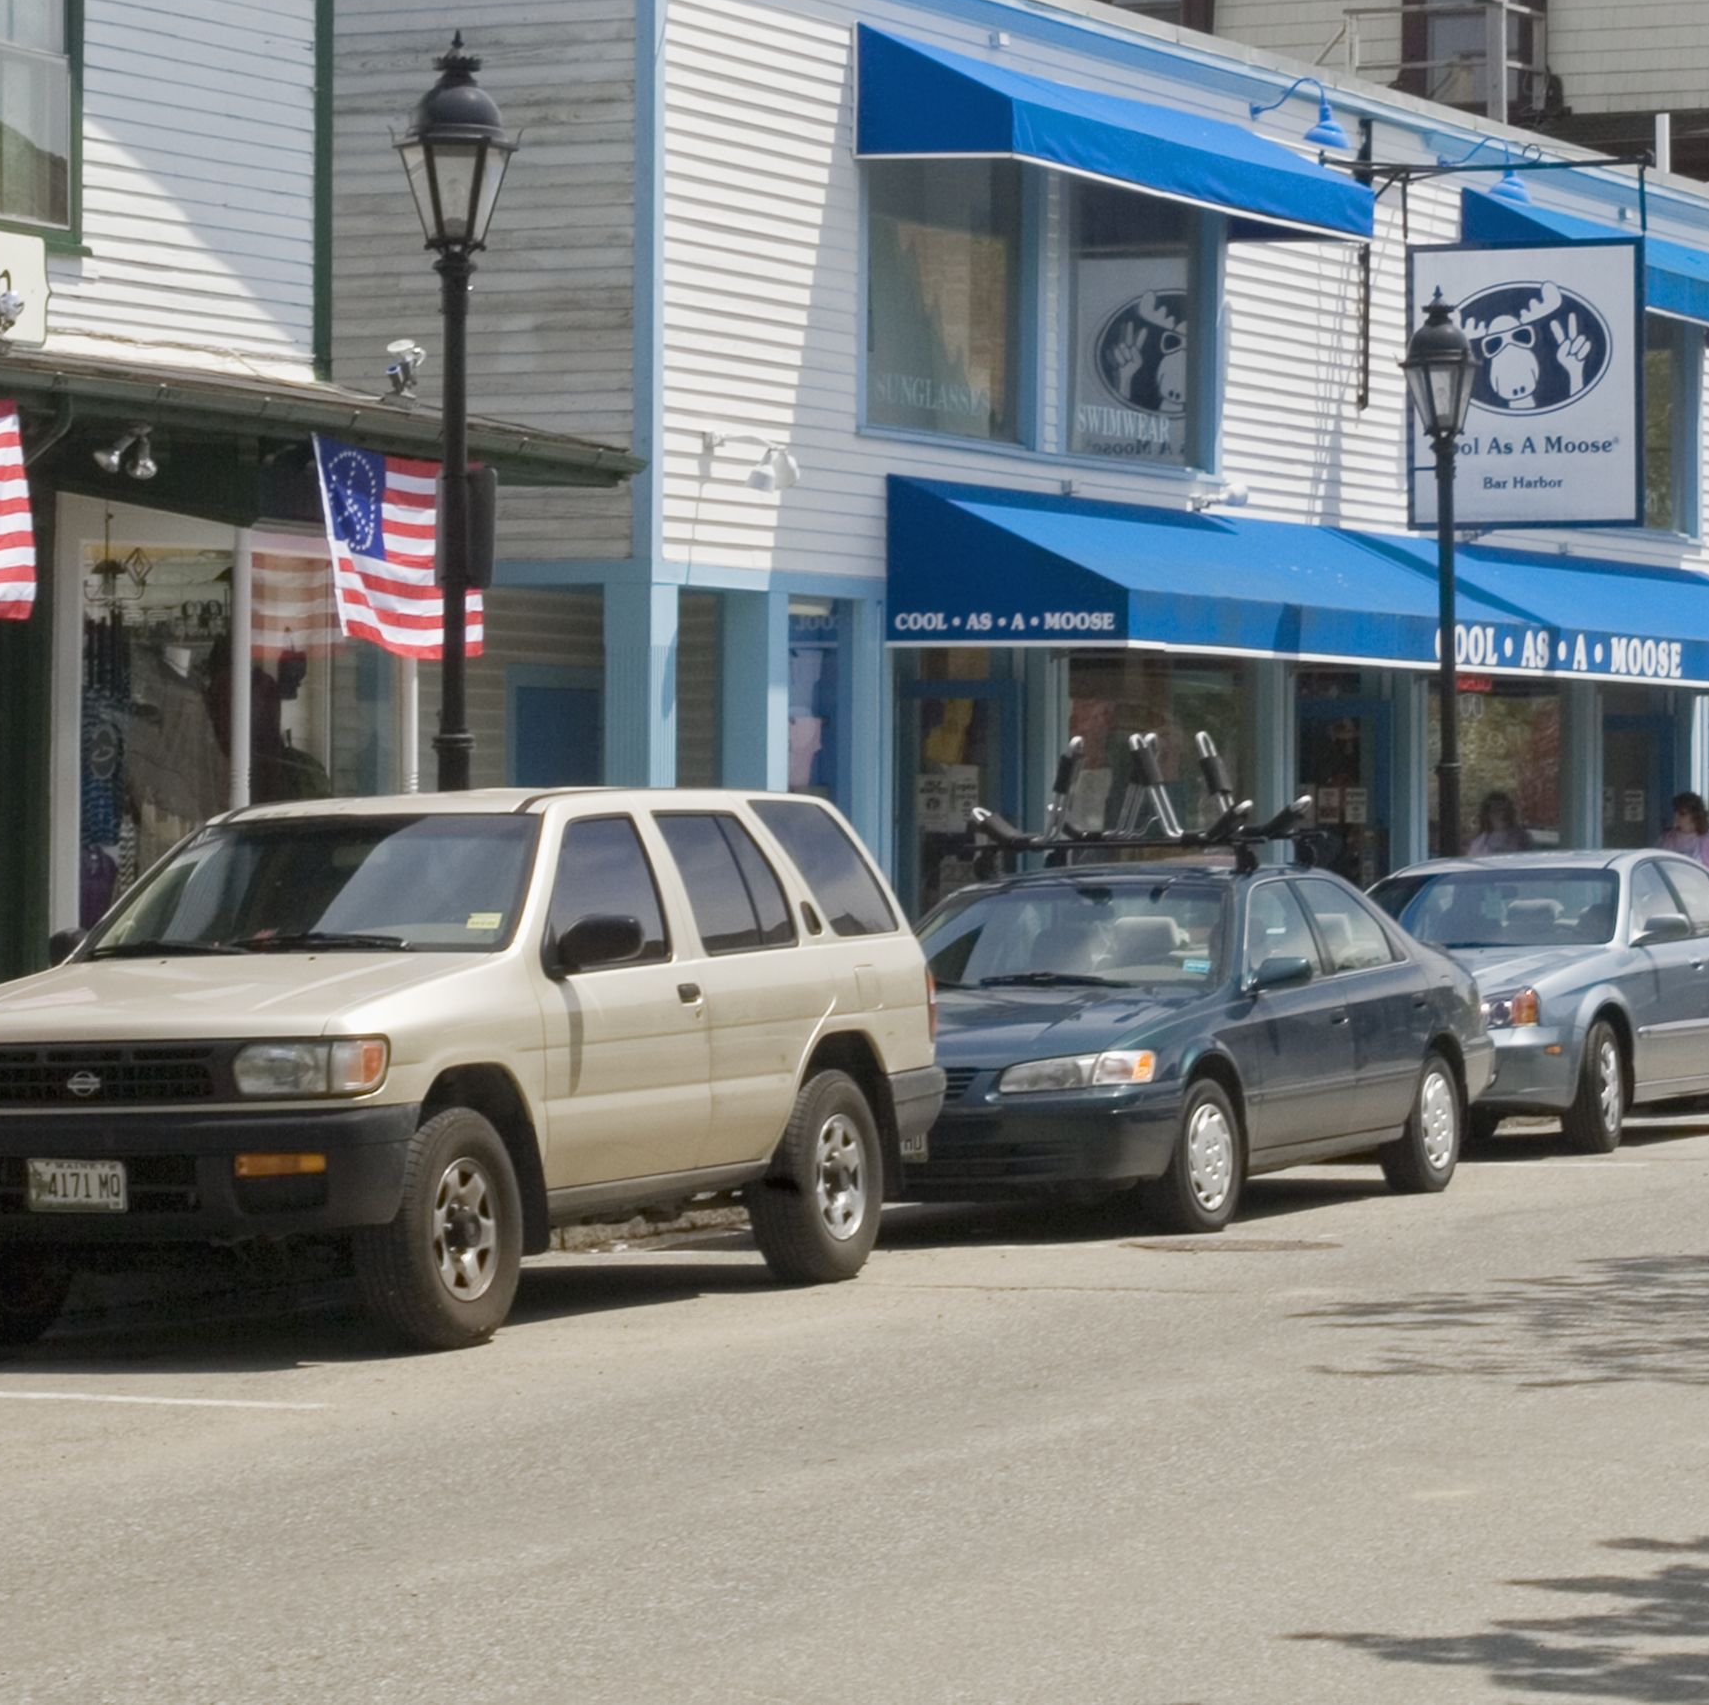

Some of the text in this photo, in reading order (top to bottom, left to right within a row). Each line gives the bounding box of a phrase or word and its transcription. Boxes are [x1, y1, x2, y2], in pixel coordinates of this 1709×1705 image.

[1077, 404, 1170, 444] SWIMWEAR
[1486, 436, 1514, 455] As
[1520, 436, 1537, 454] A
[1544, 435, 1613, 454] Moose
[1482, 476, 1563, 490] Bar Harbor
[894, 612, 1115, 631] COOL AS A MOOSE
[1520, 629, 1550, 669] AS
[1572, 633, 1588, 671] A
[1610, 636, 1683, 678] MOOSE
[48, 1172, 92, 1198] 4171
